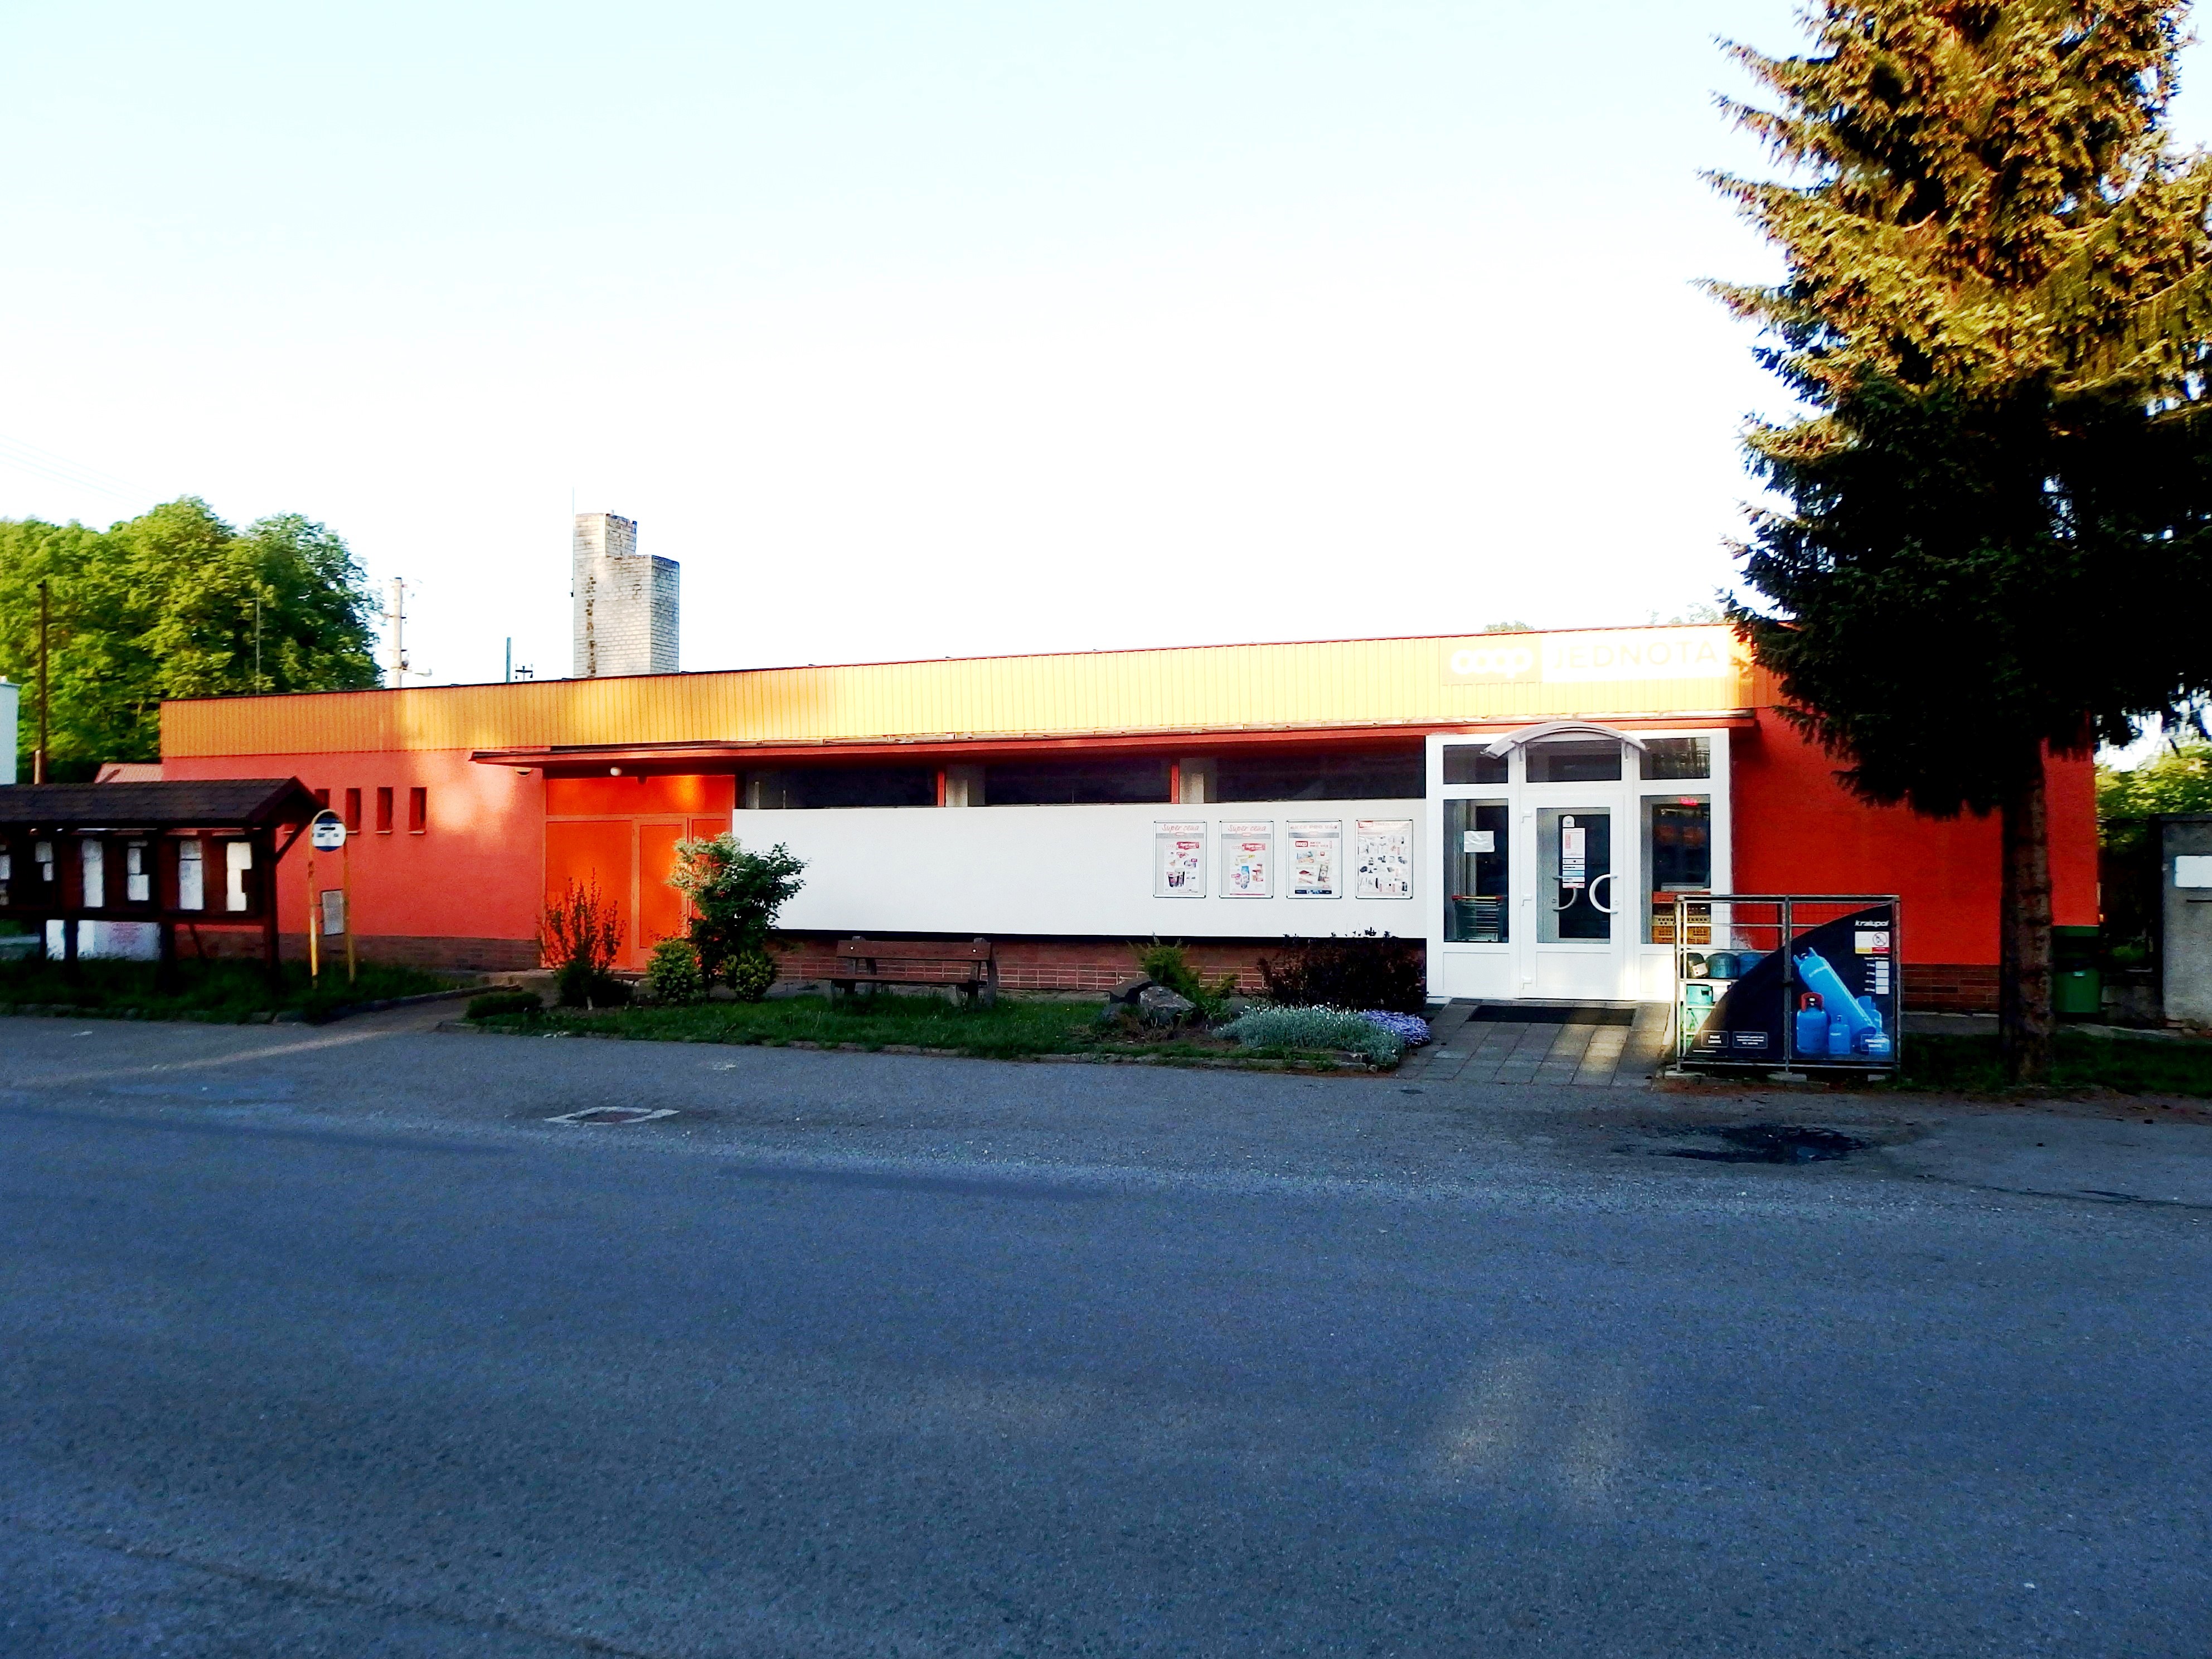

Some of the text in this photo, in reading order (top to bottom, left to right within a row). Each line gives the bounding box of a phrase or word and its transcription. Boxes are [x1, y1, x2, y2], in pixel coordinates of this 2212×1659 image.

[1553, 640, 1719, 670] JEDNOTA
[1162, 824, 1181, 833] Super
[1228, 825, 1248, 834] Super
